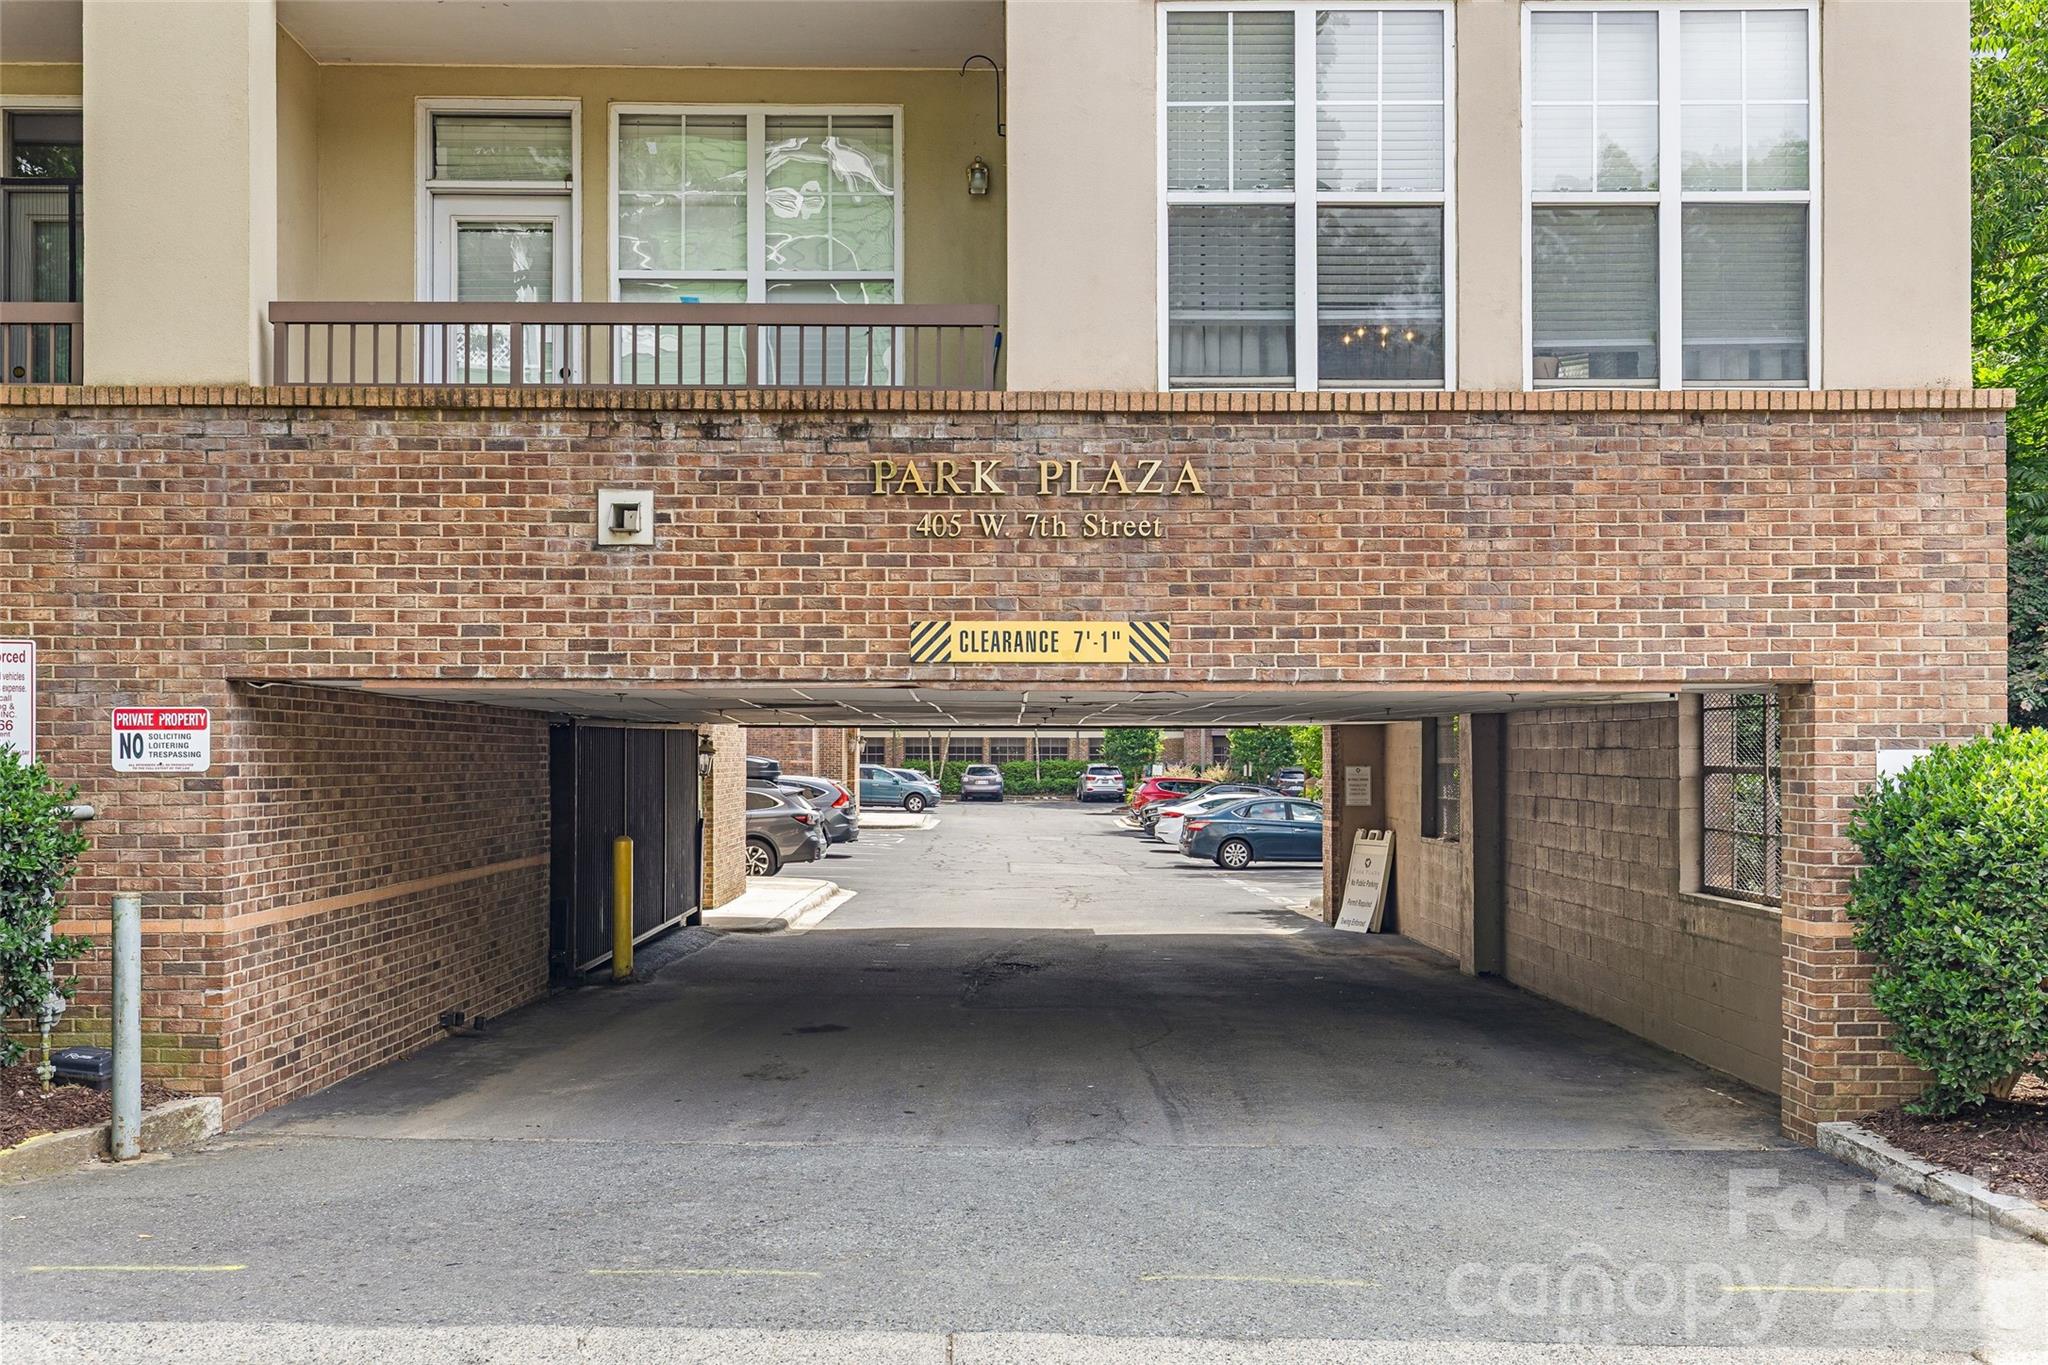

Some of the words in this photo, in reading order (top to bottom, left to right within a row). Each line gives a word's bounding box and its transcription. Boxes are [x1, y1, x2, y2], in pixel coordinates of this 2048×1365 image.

[871, 459, 1006, 495] PARK
[1037, 459, 1206, 495] PLAZA
[916, 514, 962, 538] 405
[977, 513, 1010, 538] W.
[1025, 513, 1068, 538] 7th
[1083, 513, 1163, 538] Street
[959, 631, 1059, 653] CLEARANCE
[0, 650, 25, 663] rced
[116, 713, 154, 726] PRIVATE
[159, 713, 206, 726] PROPERTY
[120, 732, 143, 759] NO
